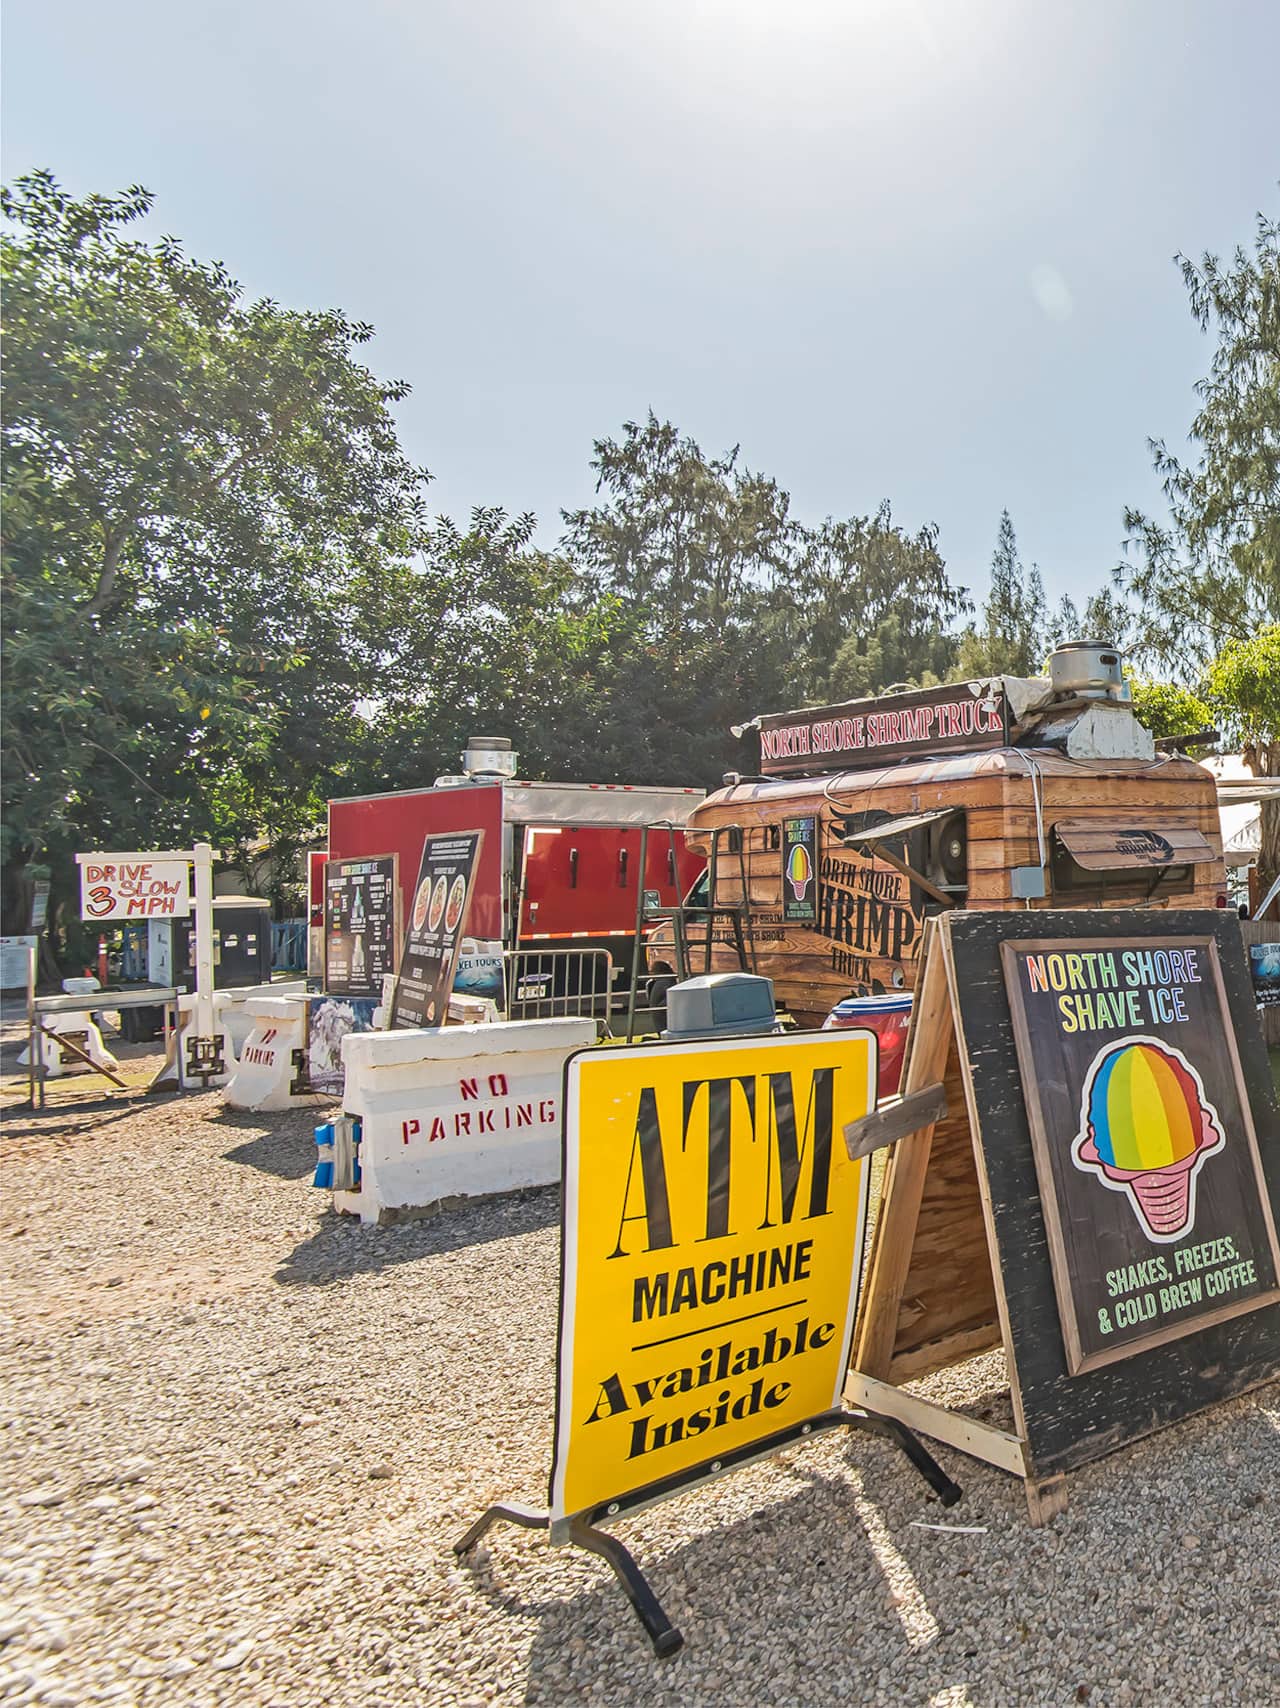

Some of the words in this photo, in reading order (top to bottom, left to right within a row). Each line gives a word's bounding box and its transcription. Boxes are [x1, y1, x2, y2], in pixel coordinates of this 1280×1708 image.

[760, 725, 810, 760] NORTH
[812, 717, 865, 754] SHORE
[867, 706, 934, 748] SHRIMP
[935, 696, 1003, 737] TRUCK
[87, 864, 152, 883] DRIVE
[118, 880, 181, 897] SLOW
[819, 855, 857, 888] ORTH
[860, 866, 902, 899] SHORE
[86, 886, 116, 916] 3
[127, 897, 175, 915] MPH
[815, 882, 915, 960] HRIMP
[832, 946, 871, 983] TRUCK
[1026, 952, 1118, 992] NORTH
[1122, 950, 1202, 987] SHORE
[1059, 990, 1144, 1033] SHAVE
[1148, 987, 1189, 1024] ICE
[460, 1074, 508, 1100] NO
[402, 1101, 555, 1144] PARKING
[606, 1065, 842, 1260] ATM
[632, 1240, 813, 1323] MACHINE
[1106, 1256, 1172, 1297] SHAKES,
[1174, 1236, 1239, 1275] FREEZES,
[1098, 1307, 1113, 1334] &
[1115, 1293, 1157, 1328] COLD
[1160, 1278, 1202, 1313] BREW
[1205, 1260, 1257, 1297] COFFEE
[583, 1318, 835, 1425] Available
[625, 1377, 792, 1461] Inside
